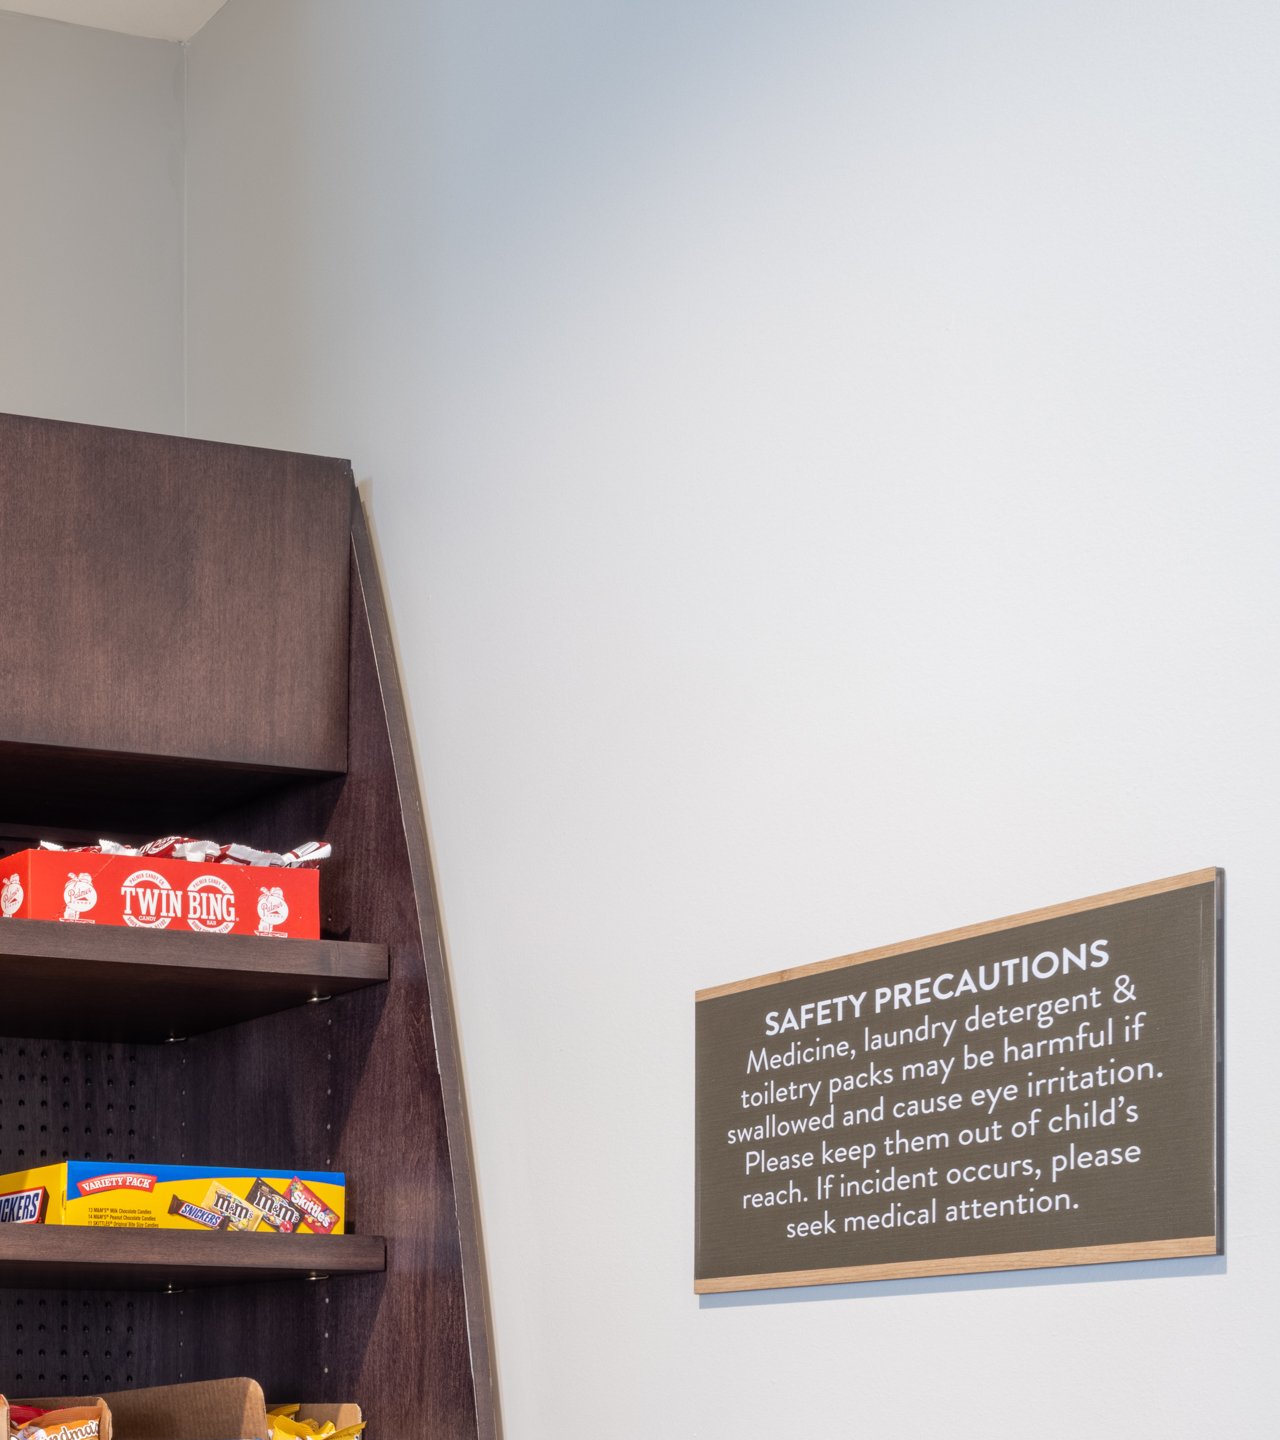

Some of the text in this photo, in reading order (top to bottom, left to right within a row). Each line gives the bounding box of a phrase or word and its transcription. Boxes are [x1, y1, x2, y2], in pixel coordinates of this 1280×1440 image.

[121, 886, 235, 921] TWIN BING
[746, 974, 1137, 1074] Medicine, laundry detergent &
[764, 938, 1110, 1037] SAFETY PRECAUTIONS
[741, 1012, 1146, 1109] toiletry packs may be harmful if
[726, 1057, 1164, 1145] swallowed and cause eye irritation.
[745, 1095, 1139, 1175] Please keep them out of child's
[82, 1175, 152, 1192] VARIETY PACK
[743, 1136, 1141, 1209] reach. If incident occurs, please
[182, 1204, 222, 1226] SNICKERS
[291, 1192, 330, 1227] Skittles
[786, 1188, 1079, 1239] seek medical attention.
